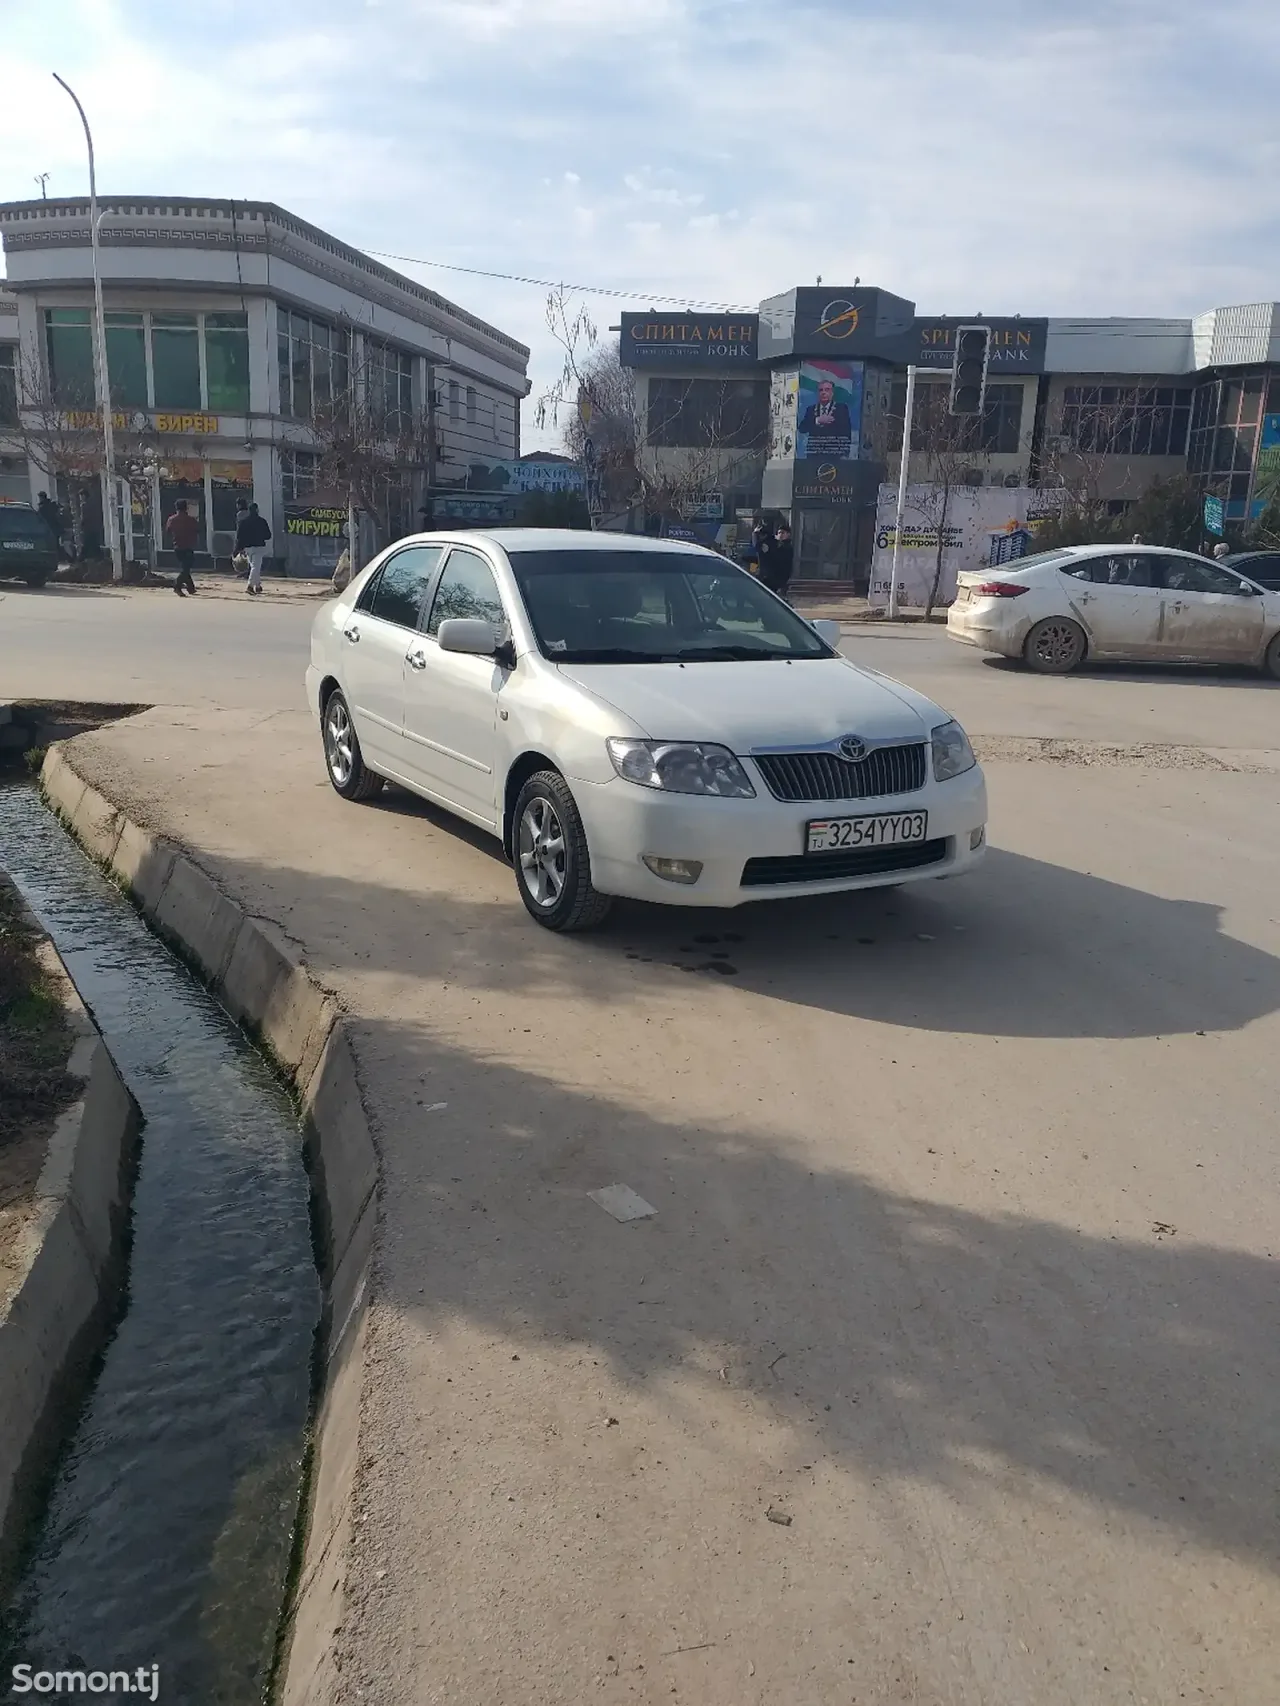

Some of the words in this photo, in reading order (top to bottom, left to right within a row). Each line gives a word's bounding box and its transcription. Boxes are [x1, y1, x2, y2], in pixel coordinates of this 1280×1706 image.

[630, 323, 753, 341] СПИТАМЕН
[920, 327, 1032, 346] SPIMEN
[706, 344, 751, 357] БОНК
[988, 349, 1030, 361] ANK
[155, 411, 219, 433] БИРЁН
[794, 484, 854, 495] СПИТАМЕН
[880, 524, 900, 532] ХОН
[876, 531, 889, 549] 6
[889, 538, 964, 549] эектромбил
[828, 815, 923, 847] 3254YY03
